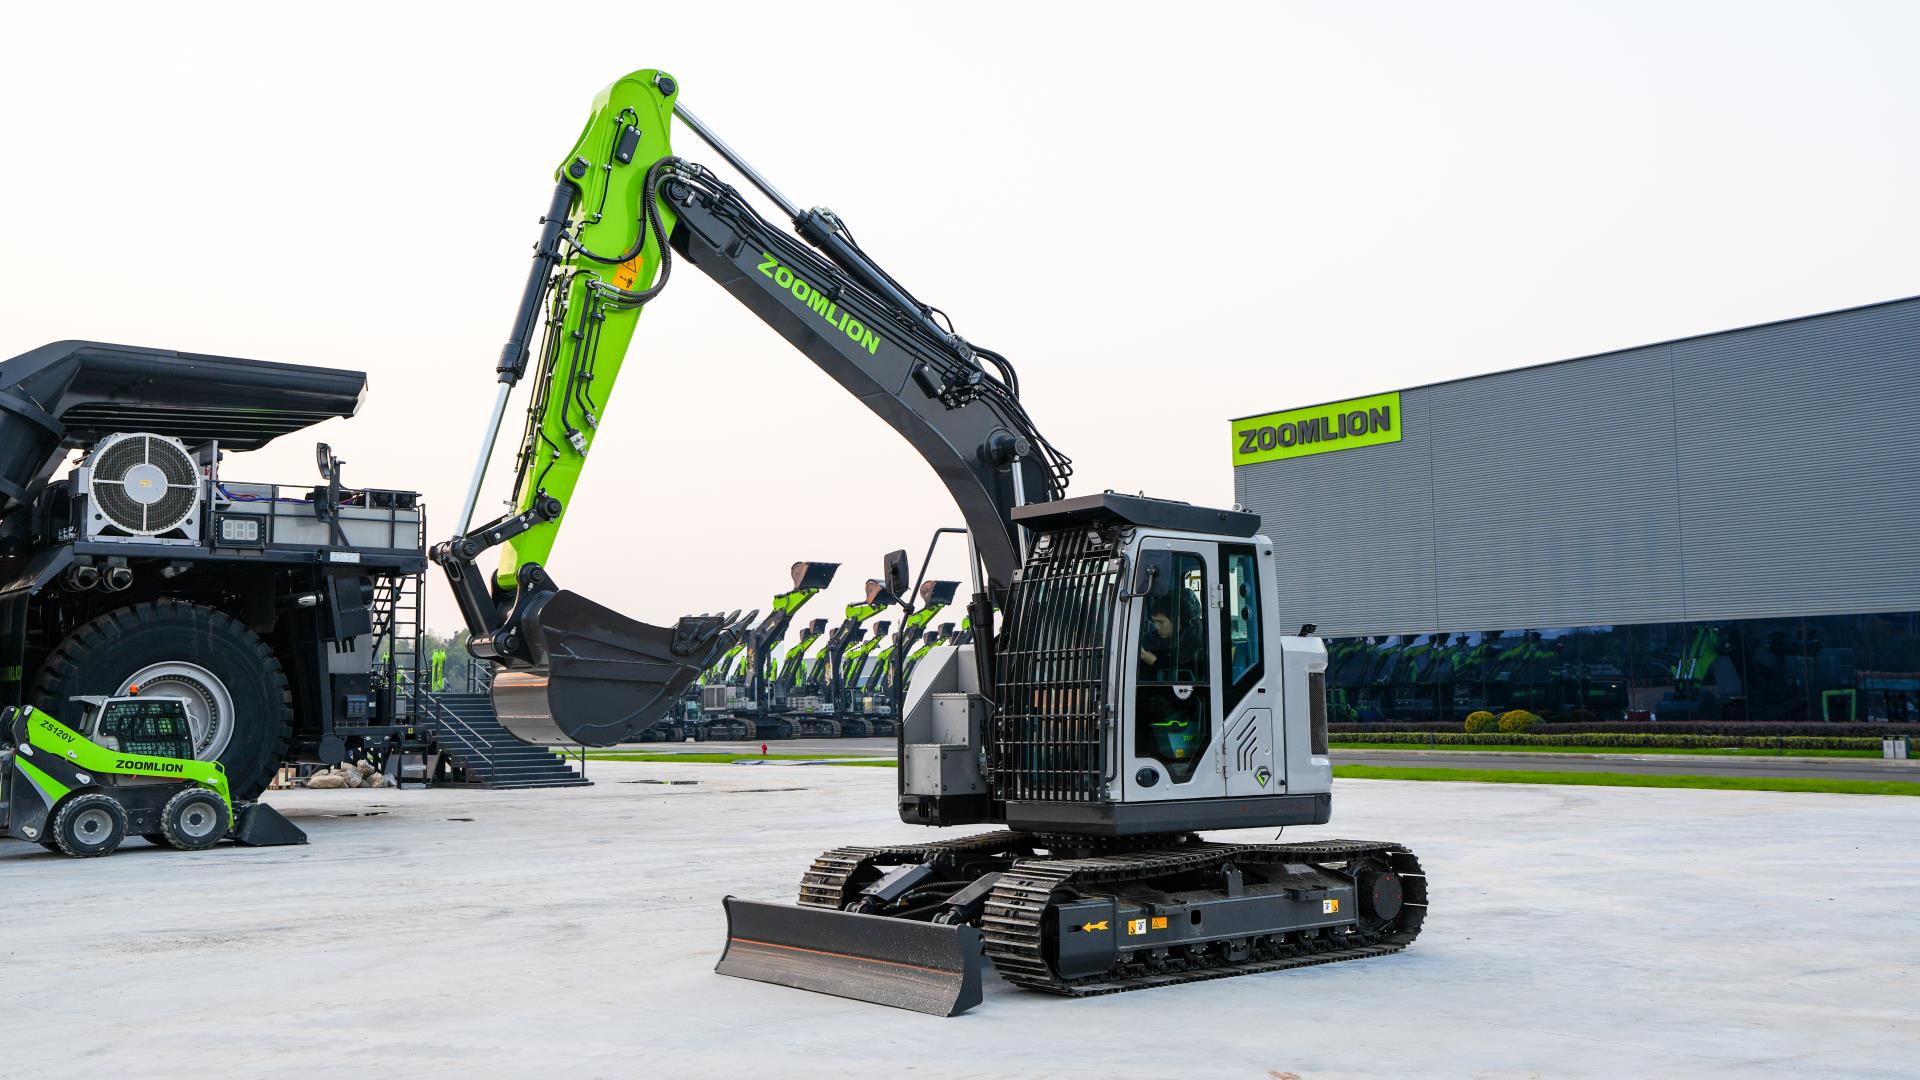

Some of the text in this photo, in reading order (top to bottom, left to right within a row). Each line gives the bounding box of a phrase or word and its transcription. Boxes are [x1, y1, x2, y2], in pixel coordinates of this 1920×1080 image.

[757, 252, 880, 355] ZOOMLION
[1238, 406, 1391, 454] ZOOMLION
[40, 720, 75, 743] ZS120V
[116, 760, 183, 773] ZOOMLION
